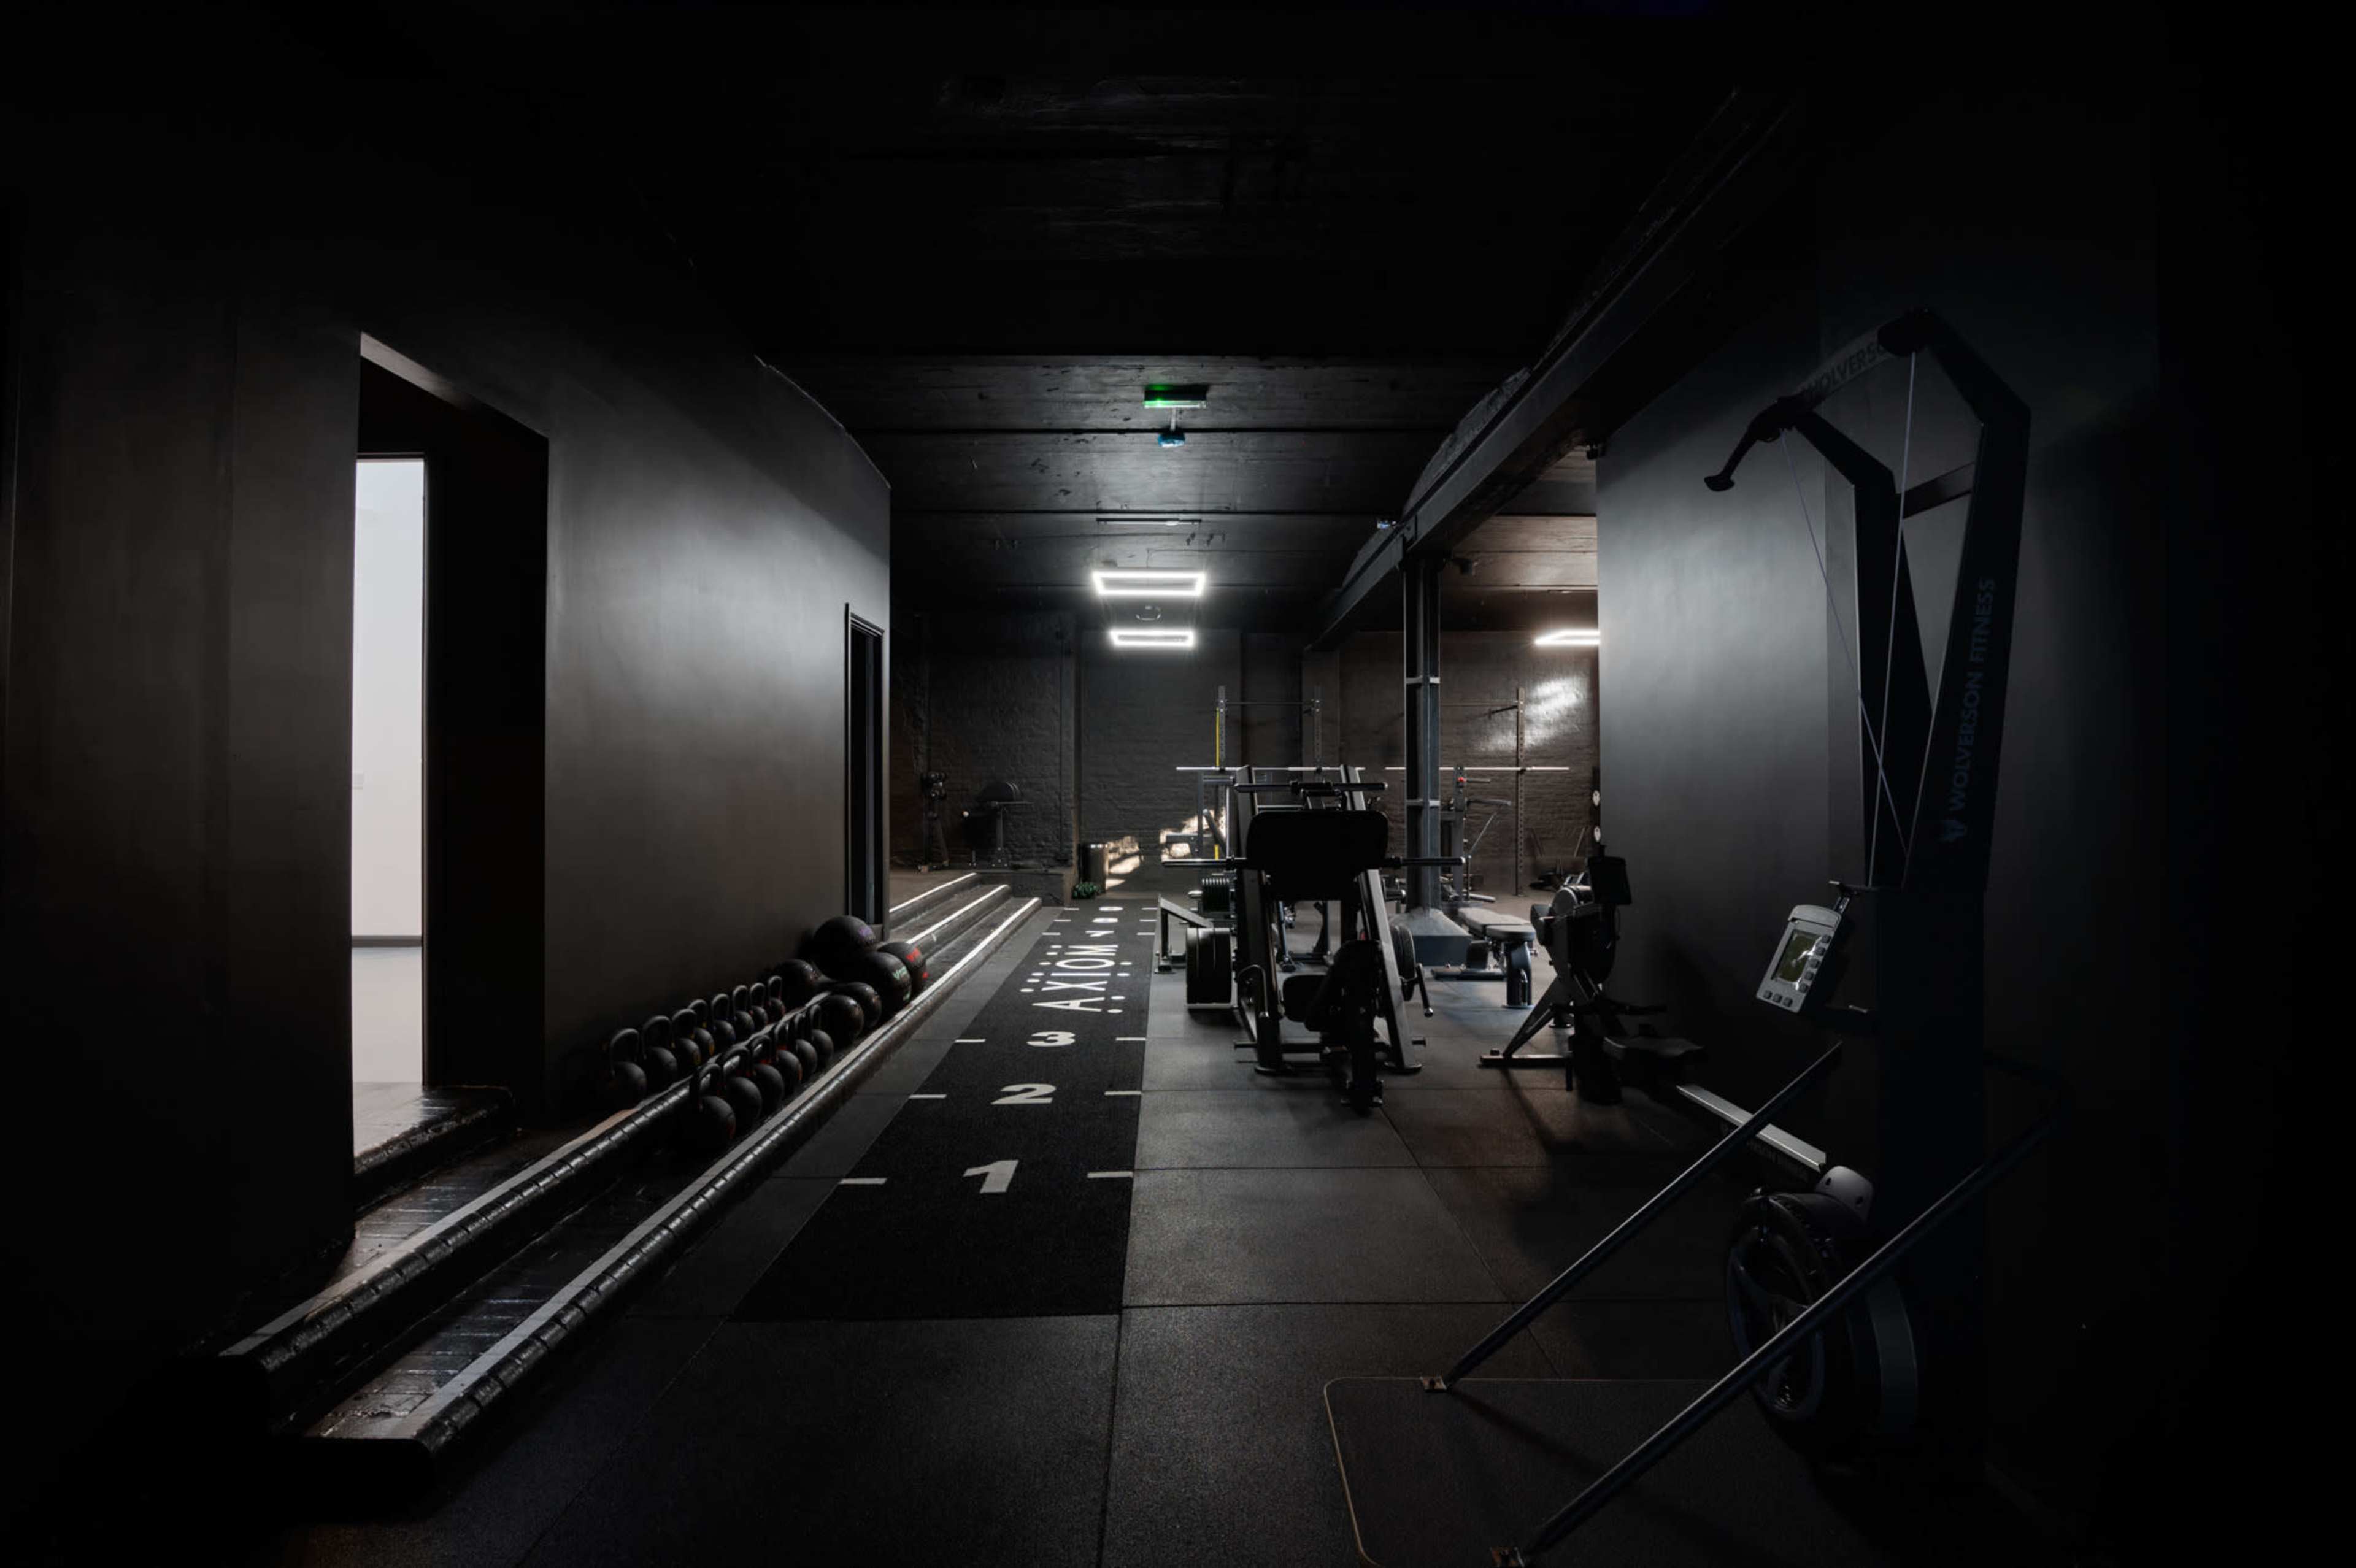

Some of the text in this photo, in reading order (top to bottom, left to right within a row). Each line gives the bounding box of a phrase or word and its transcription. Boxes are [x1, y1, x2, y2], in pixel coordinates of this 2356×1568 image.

[1949, 576, 1997, 811] WOLVERSON FITNESS
[1032, 943, 1119, 1012] AXIOM
[1026, 1031, 1076, 1047] 3
[990, 1083, 1057, 1105] 2
[963, 1158, 1019, 1194] 1
